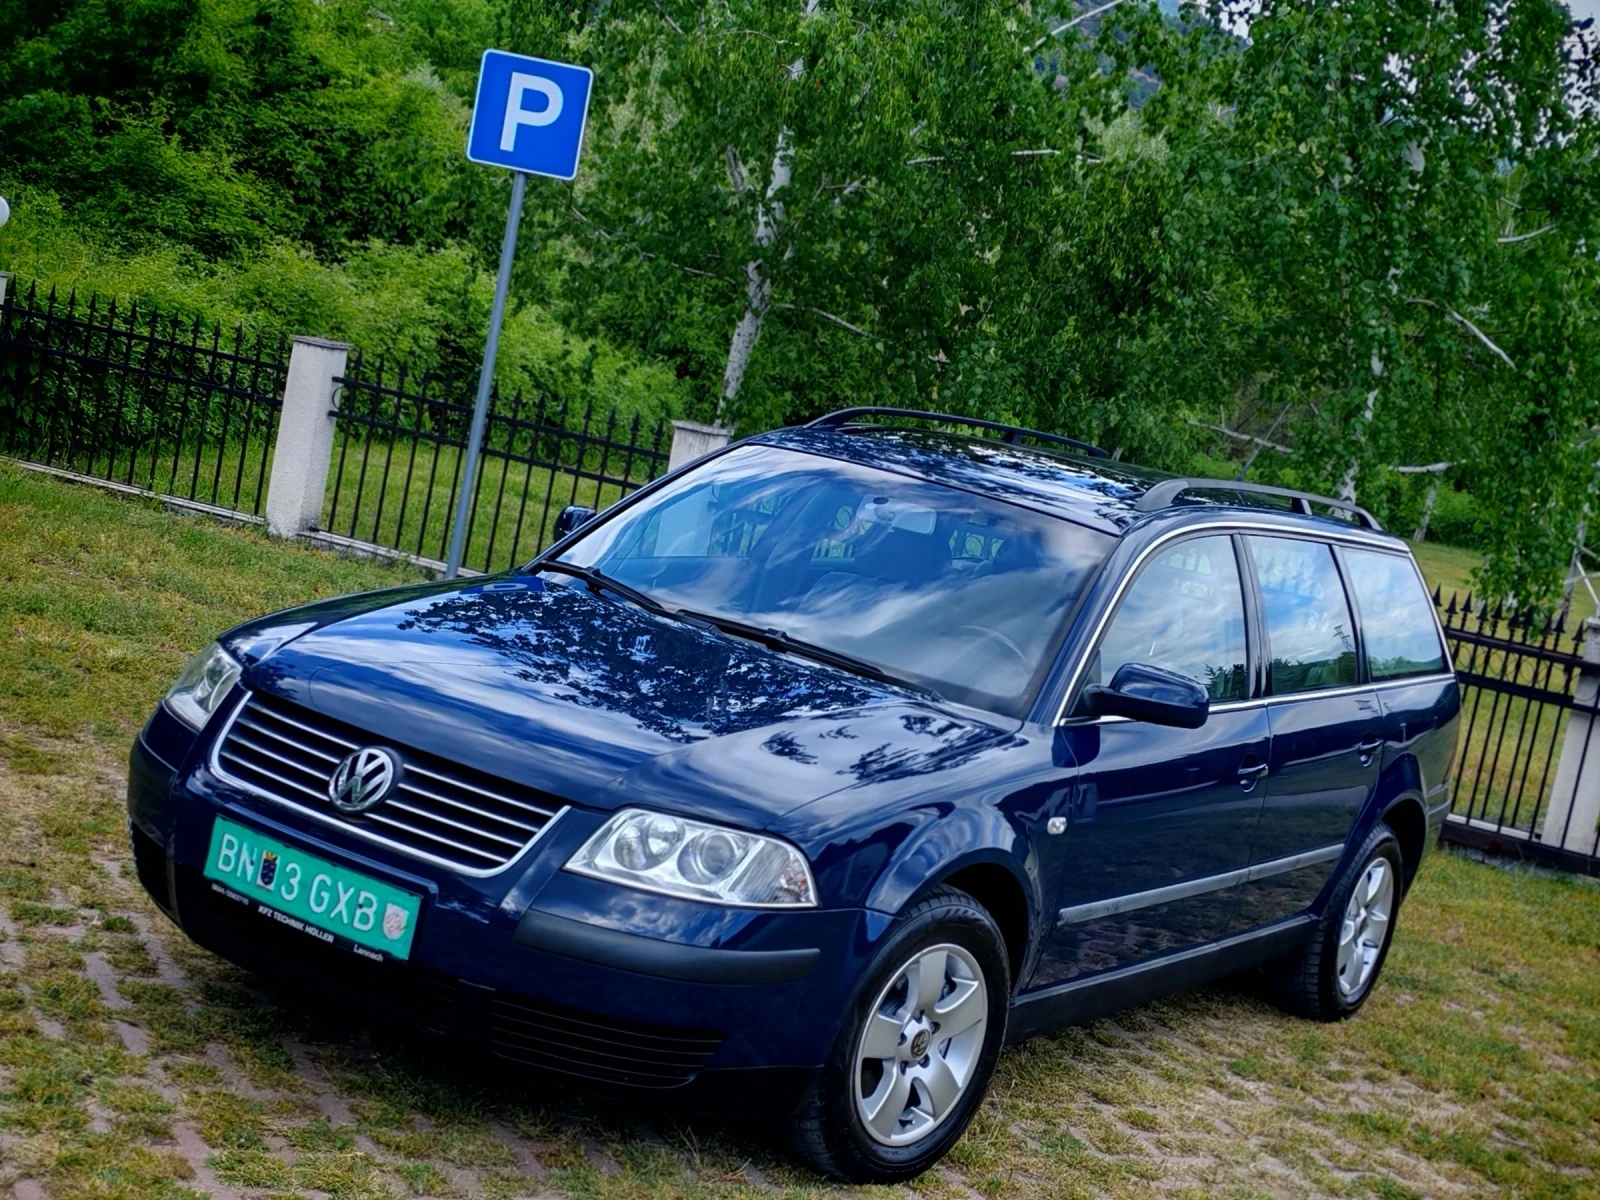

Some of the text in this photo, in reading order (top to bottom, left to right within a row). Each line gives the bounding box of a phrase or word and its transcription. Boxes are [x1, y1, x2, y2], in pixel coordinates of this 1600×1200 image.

[500, 71, 564, 152] P
[217, 833, 257, 882] BN
[280, 862, 301, 901] 3
[309, 874, 378, 931] GXB
[258, 904, 273, 918] KFZ
